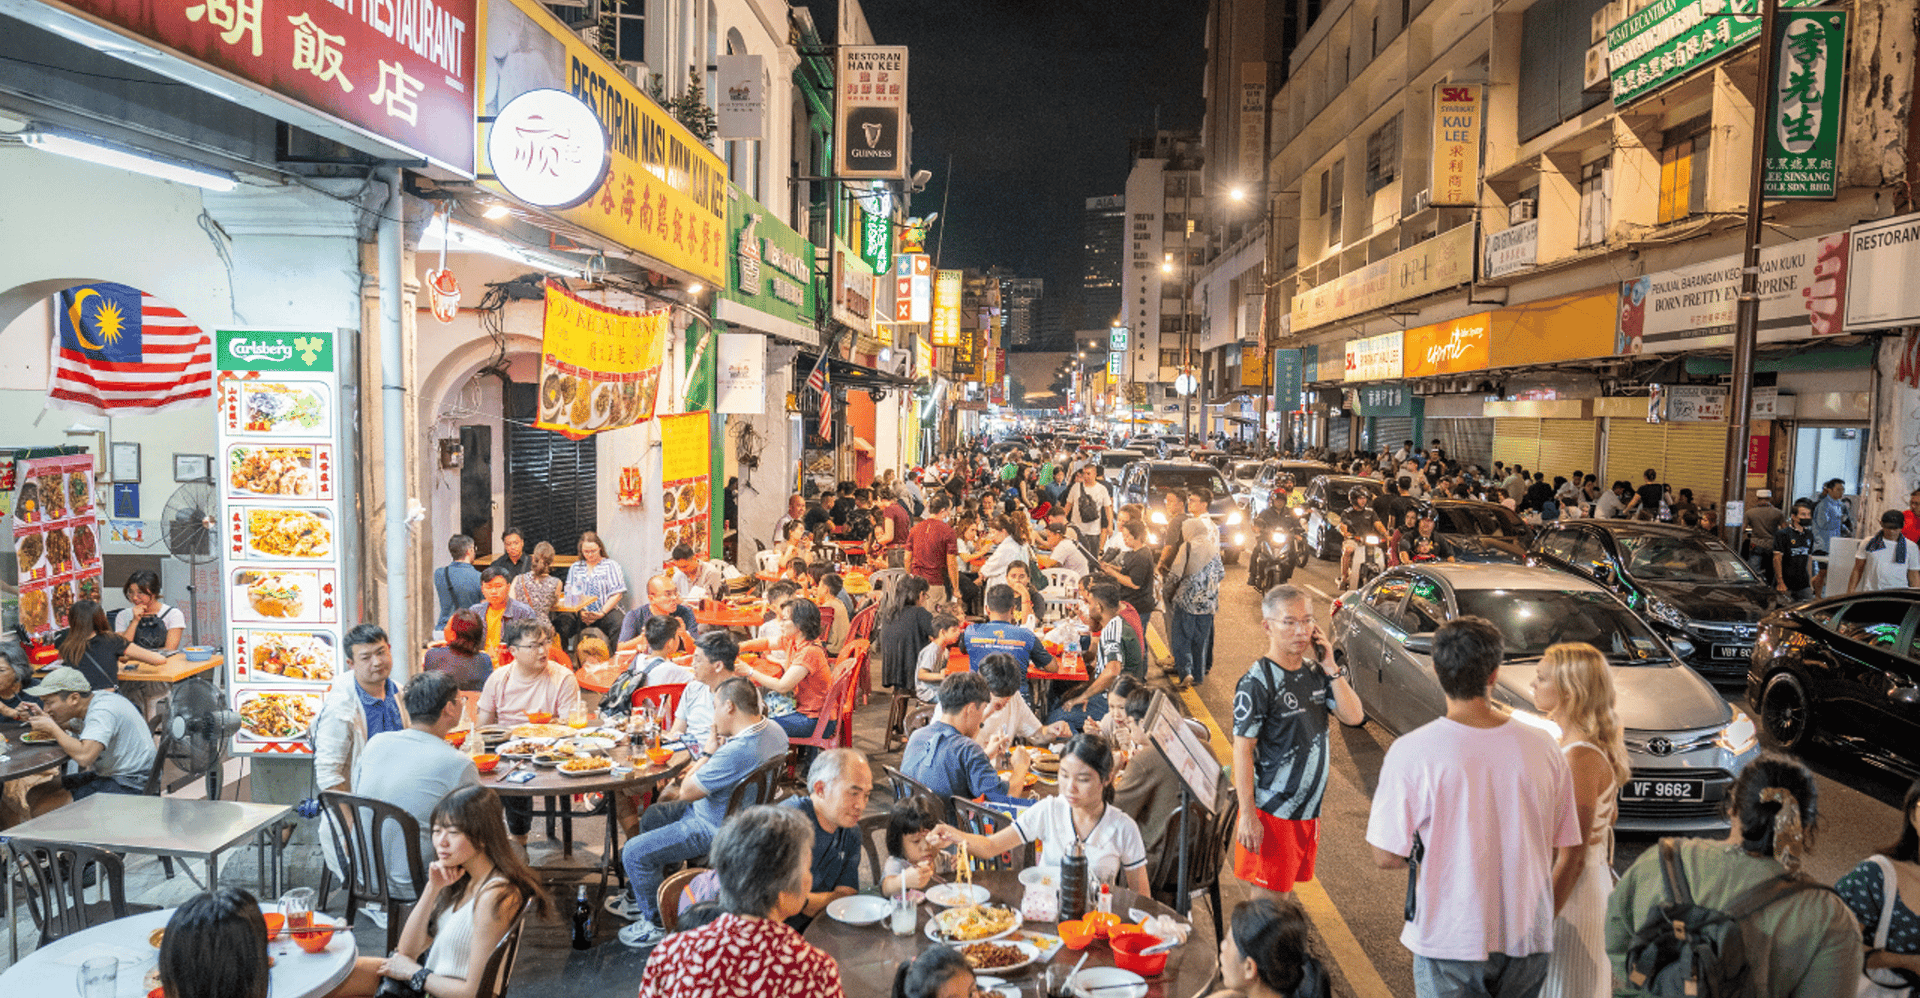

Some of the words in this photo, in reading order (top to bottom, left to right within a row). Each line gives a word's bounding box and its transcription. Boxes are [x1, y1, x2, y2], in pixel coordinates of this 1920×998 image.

[185, 0, 425, 127] 湖飯店
[848, 53, 901, 61] RESTORAN
[848, 62, 874, 71] HAN
[878, 62, 901, 71] KEE
[1781, 23, 1826, 142] 李先生
[1442, 88, 1474, 102] SKL
[572, 55, 638, 162] RESTORAN
[1443, 116, 1472, 128] KAU
[1445, 130, 1469, 142] LEE
[851, 149, 892, 158] GUINNESS
[1447, 145, 1464, 202] 求利商行
[1783, 171, 1831, 182] SINSANG
[1856, 226, 1920, 251] RESTORAN
[1681, 270, 1723, 289] BARANGAN
[1780, 254, 1806, 270] KUKU
[1655, 292, 1682, 312] BORN
[1682, 286, 1723, 308] PRETTY
[1725, 275, 1798, 301] ENRPRISE
[229, 338, 293, 362] Carlsberg
[1634, 782, 1652, 796] VF
[1655, 782, 1692, 797] 9662
